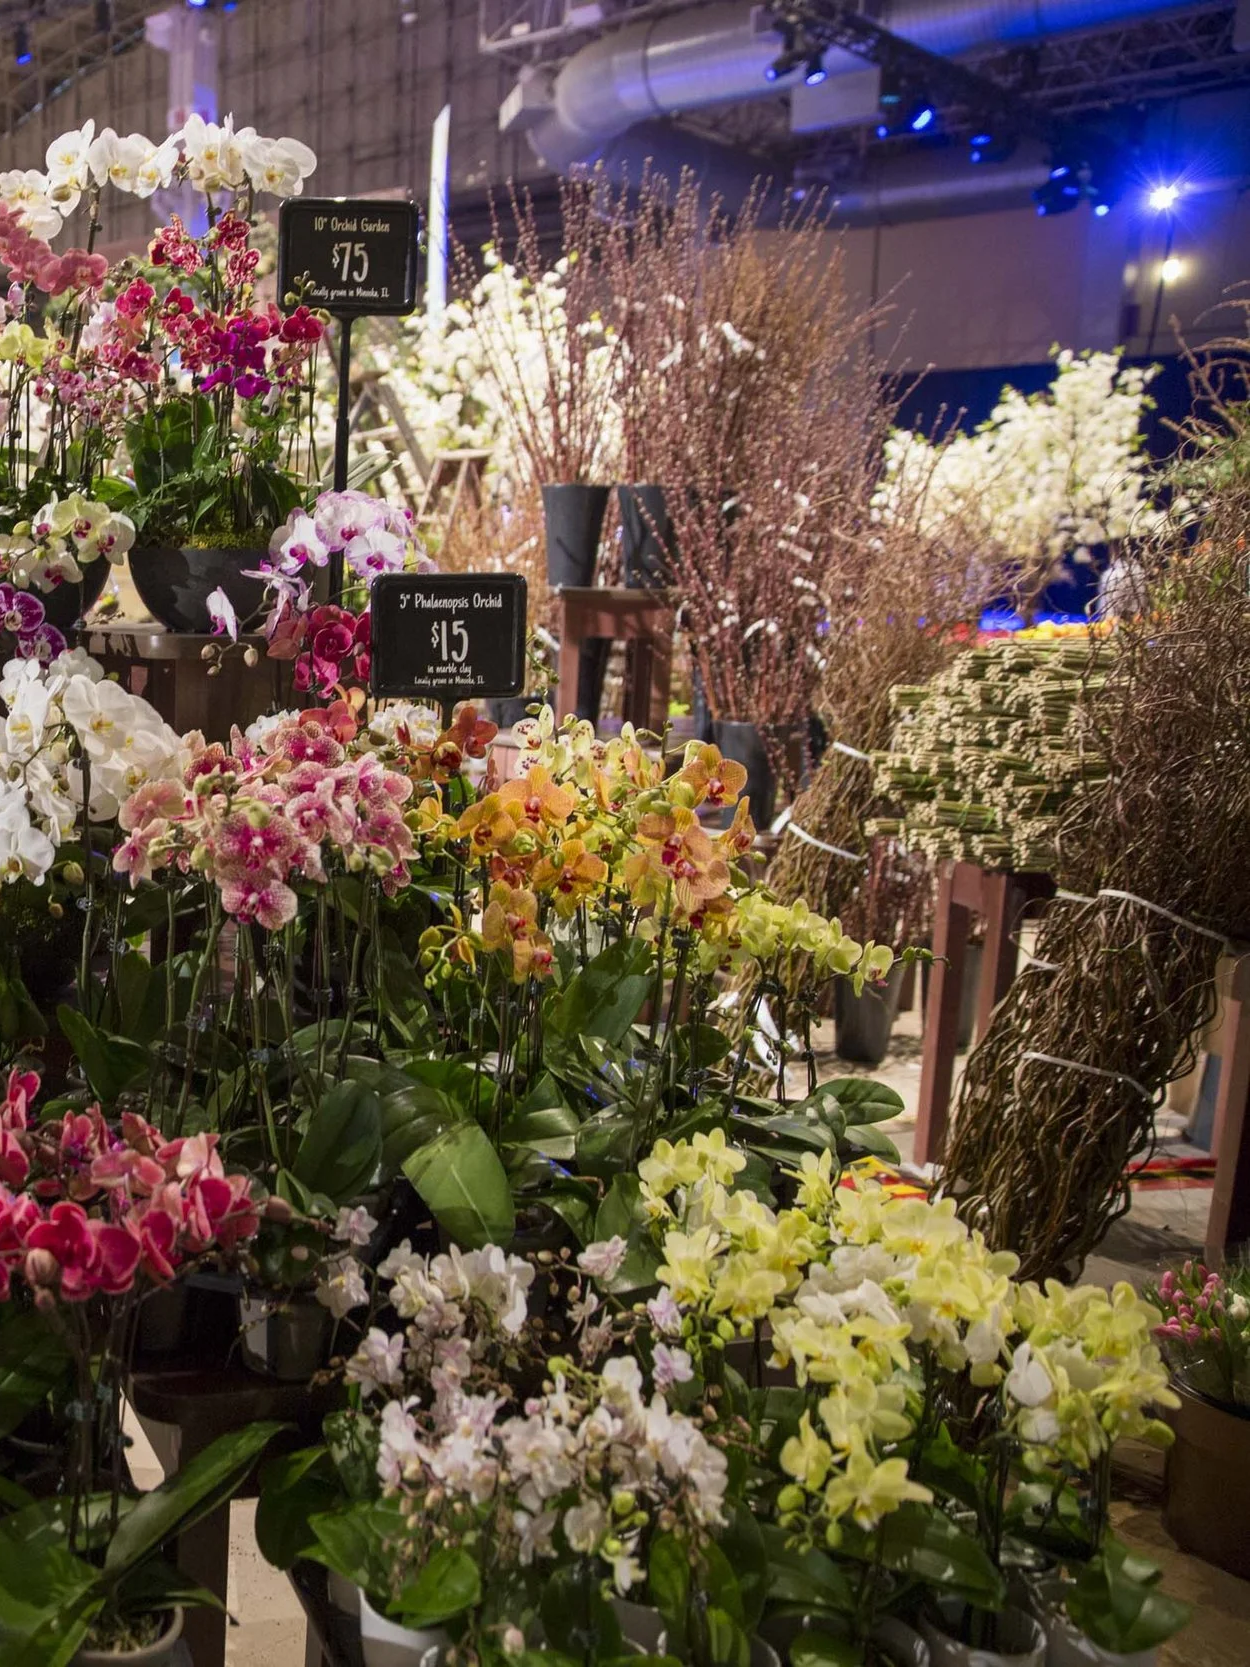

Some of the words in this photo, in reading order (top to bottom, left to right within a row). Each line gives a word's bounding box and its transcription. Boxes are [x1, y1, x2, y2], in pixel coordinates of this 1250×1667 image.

[314, 216, 327, 231] 10"
[331, 217, 357, 232] Orchid
[361, 217, 390, 232] Garden
[332, 241, 369, 283] $75
[330, 288, 347, 300] grown
[349, 287, 354, 297] in
[381, 287, 390, 298] IL
[400, 593, 411, 609] 5"
[415, 593, 469, 614] Phalaenopsis
[473, 592, 502, 608] Orchid
[431, 620, 469, 663] $15
[427, 665, 434, 673] in
[436, 663, 457, 673] marble
[459, 663, 472, 676] clay
